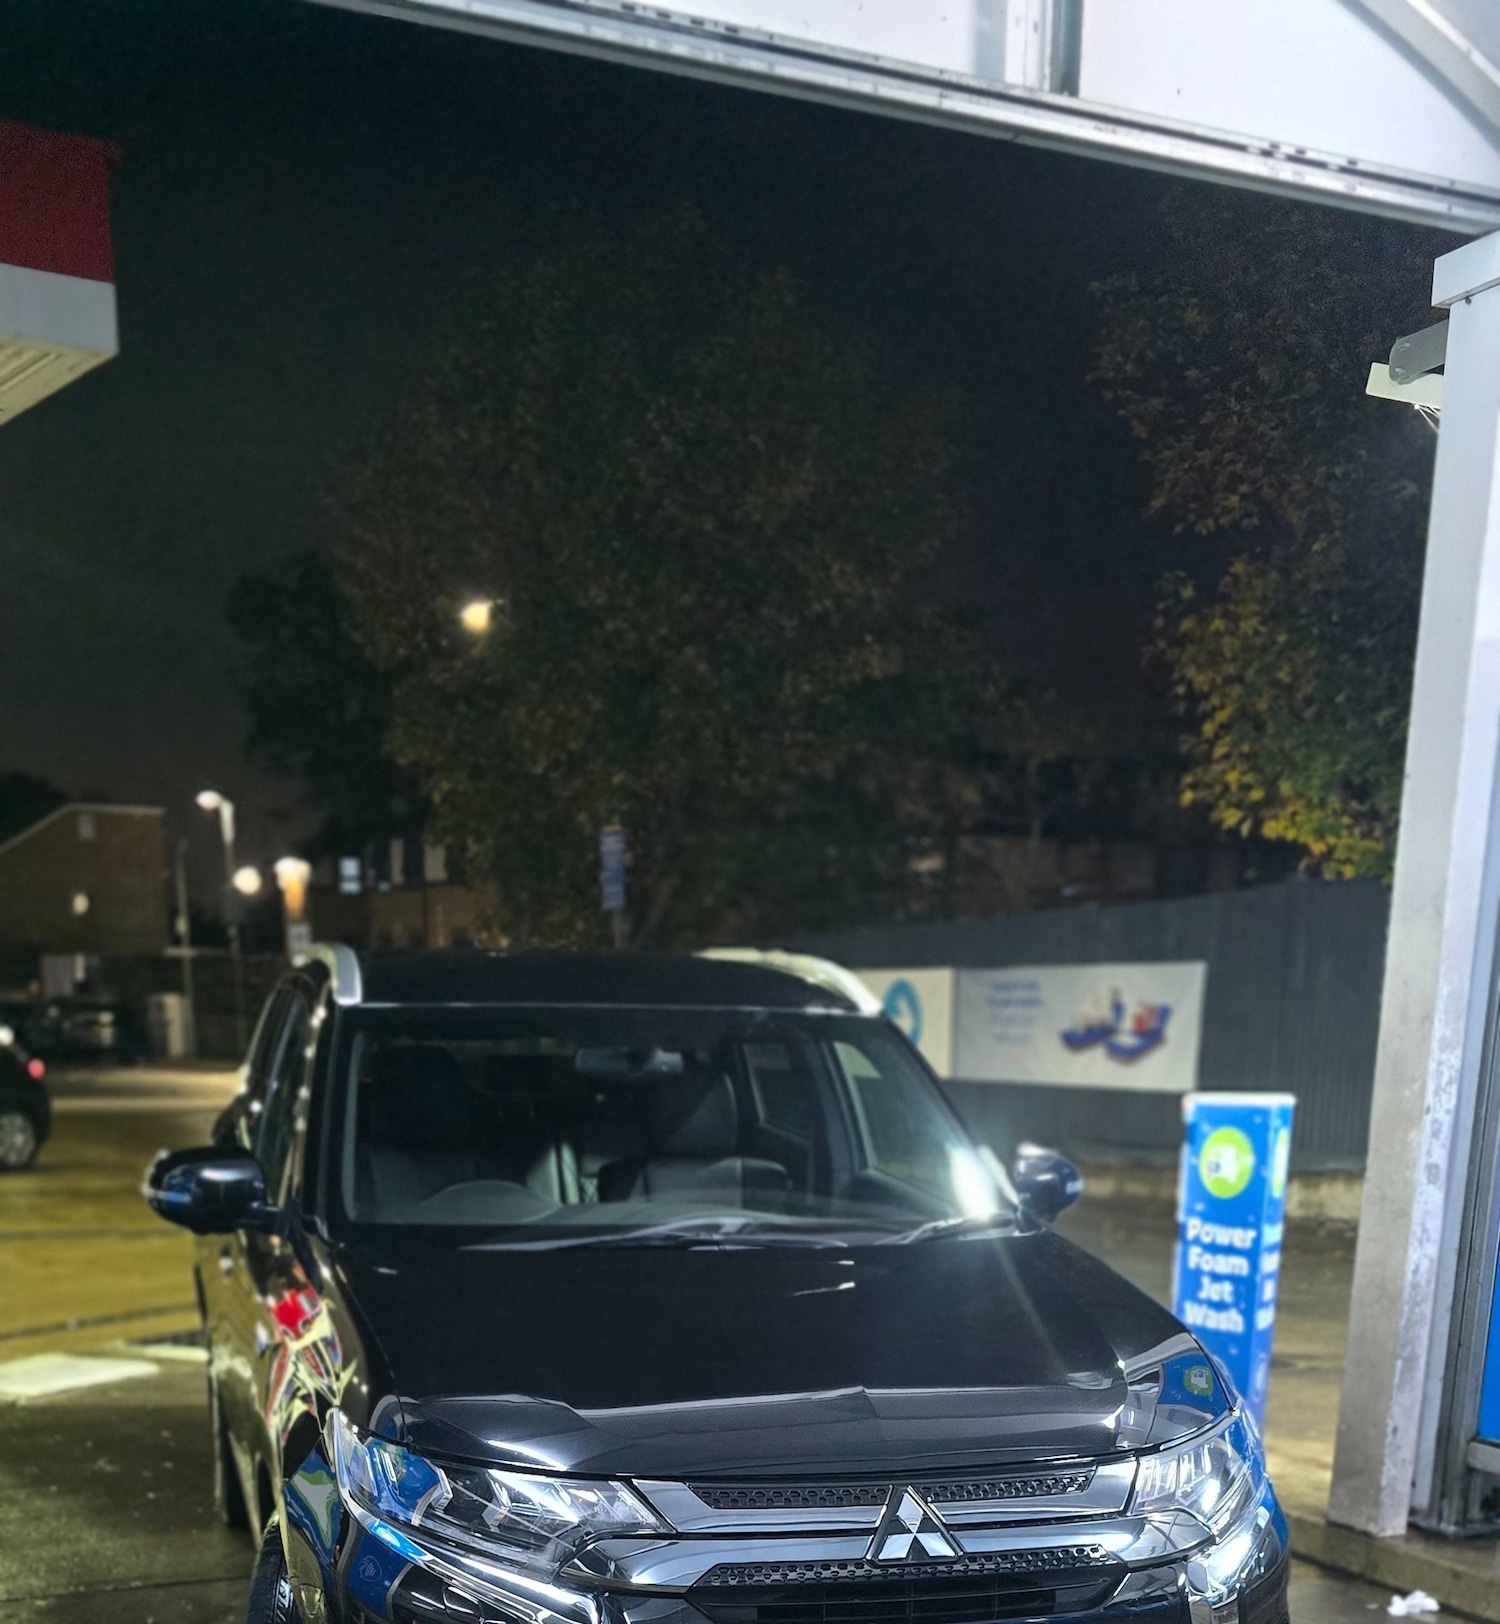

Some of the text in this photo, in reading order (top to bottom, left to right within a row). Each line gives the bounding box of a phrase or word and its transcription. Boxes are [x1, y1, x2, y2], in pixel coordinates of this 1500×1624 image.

[1186, 1217, 1257, 1249] Power
[1188, 1246, 1249, 1276] Foam
[1198, 1275, 1234, 1303] Jet
[1184, 1300, 1244, 1333] Wash
